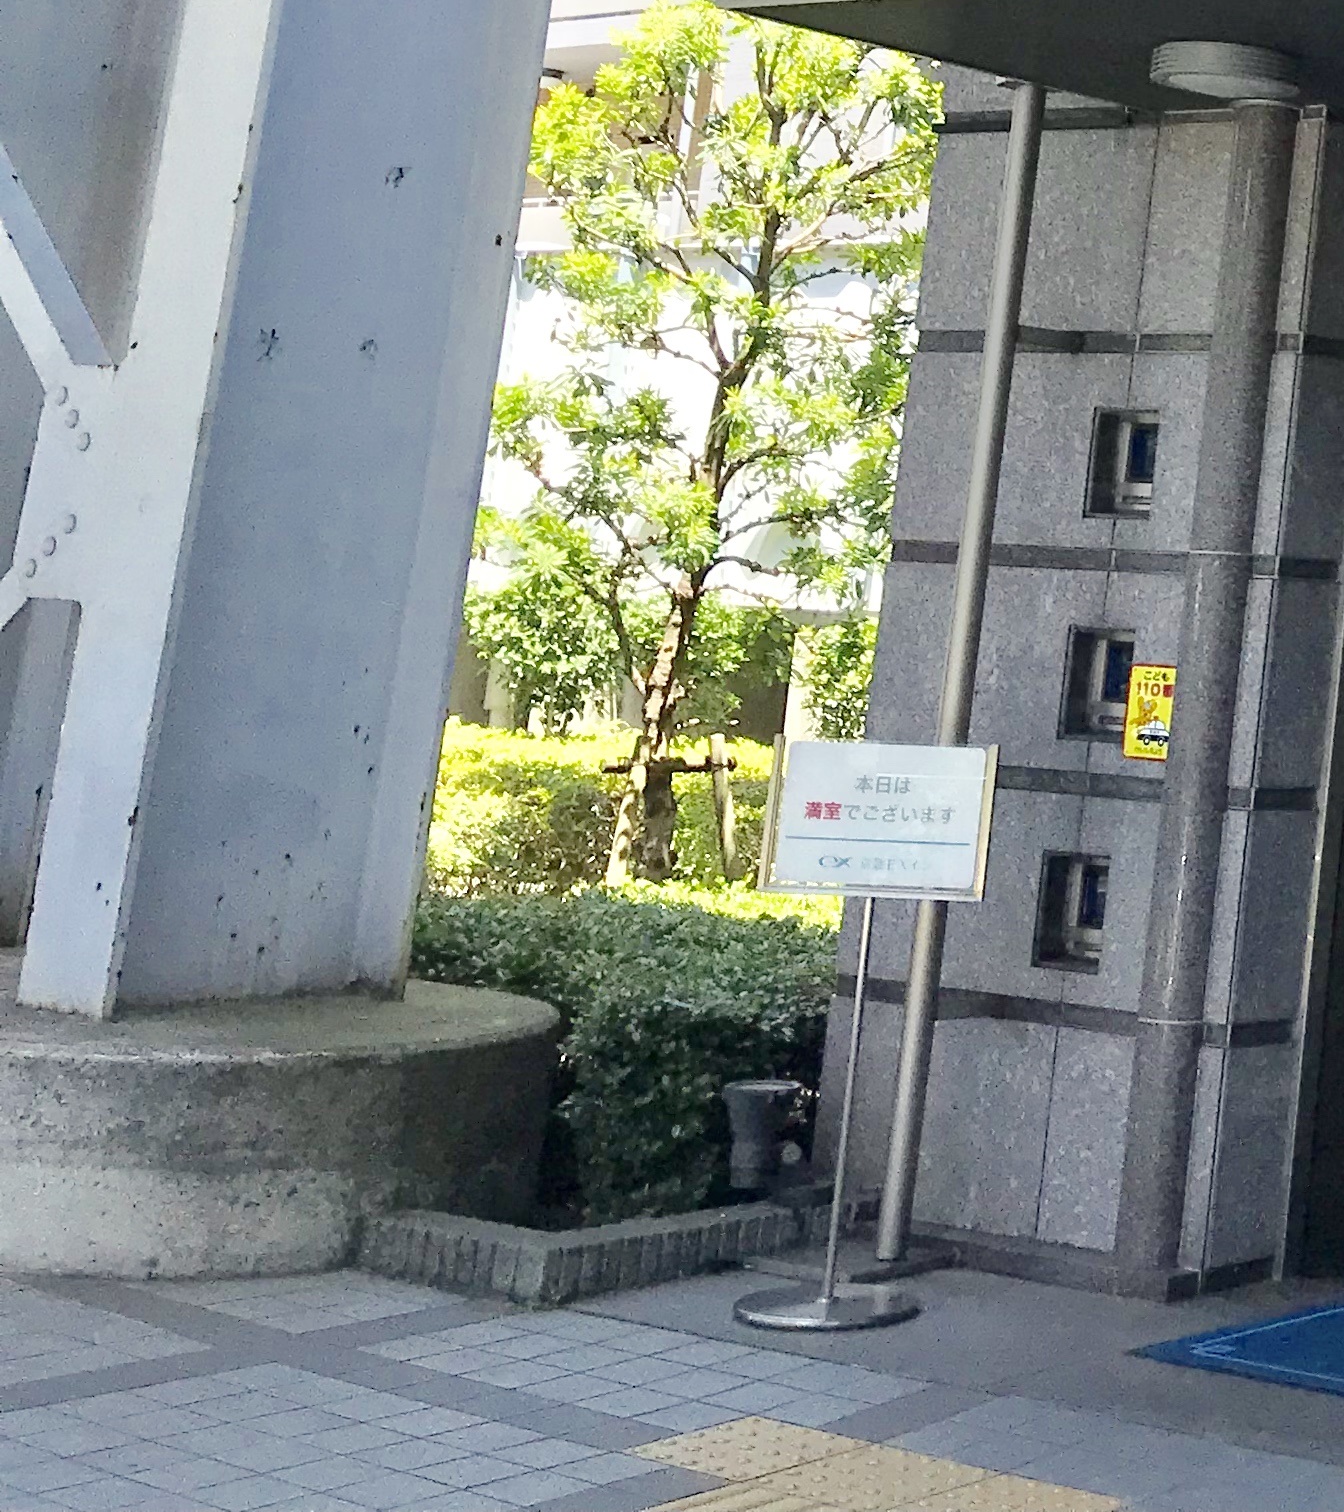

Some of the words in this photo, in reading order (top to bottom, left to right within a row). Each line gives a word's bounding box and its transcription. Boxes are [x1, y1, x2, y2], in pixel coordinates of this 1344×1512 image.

[1144, 671, 1170, 682] こども
[855, 775, 912, 795] 本日は
[804, 801, 956, 824] 満室でございます
